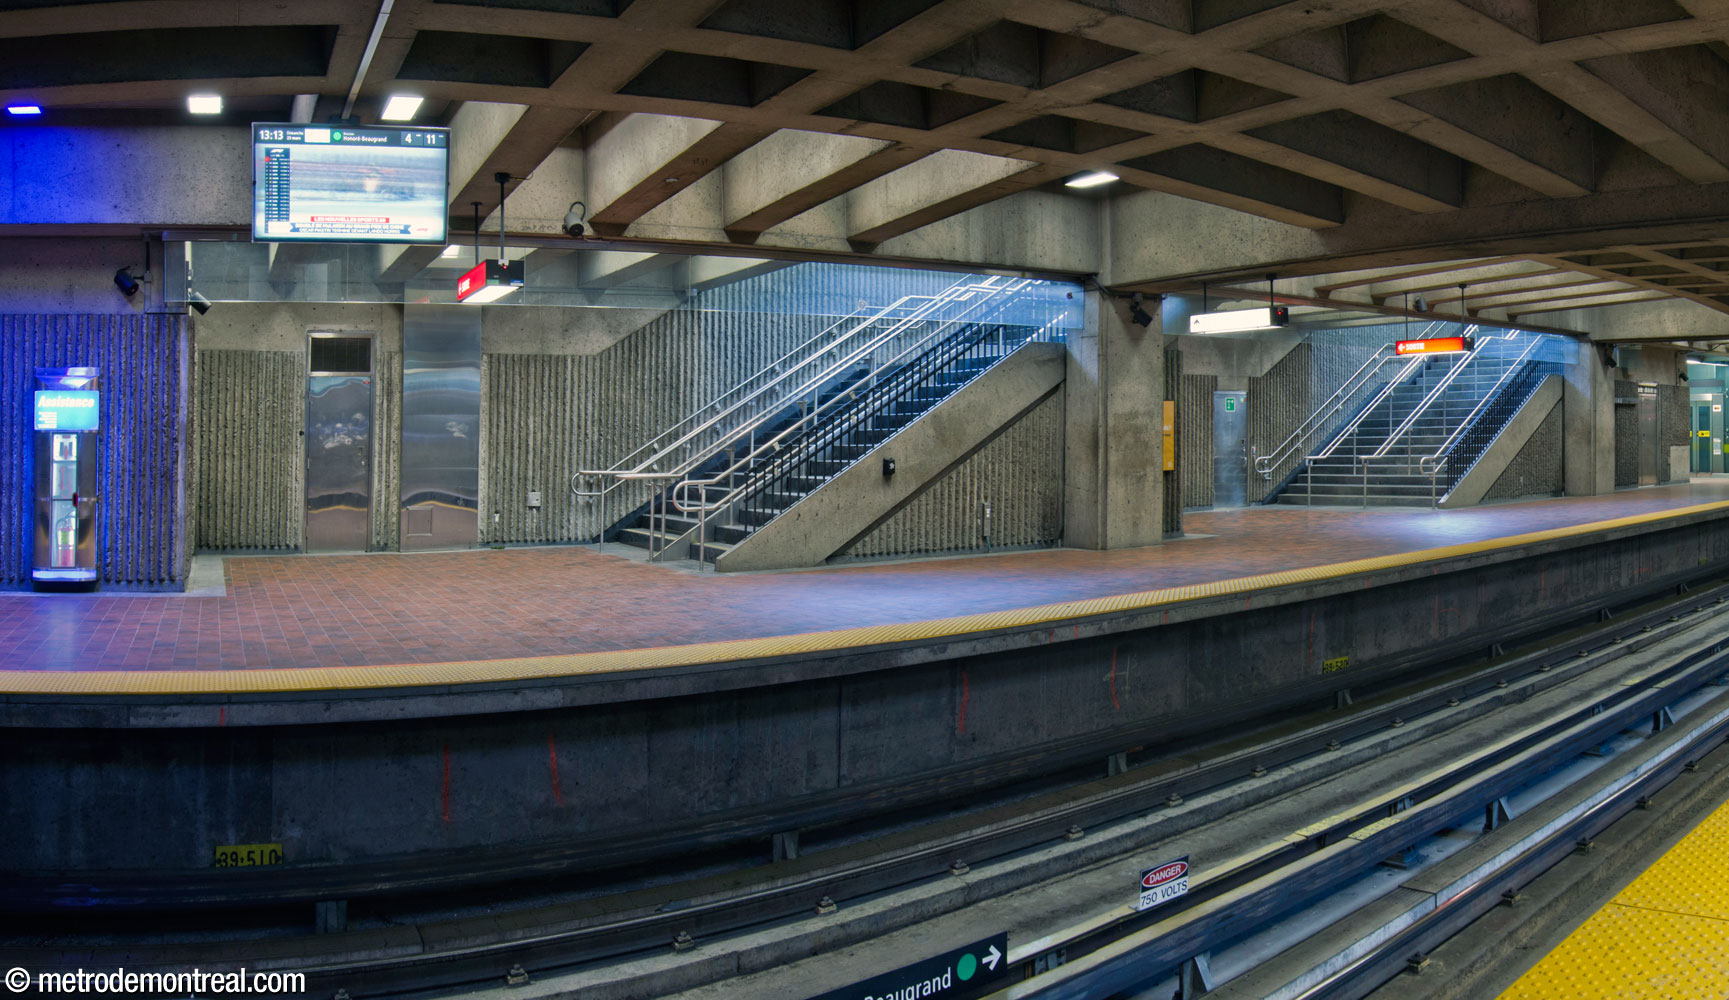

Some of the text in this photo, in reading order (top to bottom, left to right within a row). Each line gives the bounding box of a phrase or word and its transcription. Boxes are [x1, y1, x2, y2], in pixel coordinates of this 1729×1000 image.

[259, 130, 284, 140] 13:13
[405, 133, 412, 144] 4
[426, 134, 436, 144] 11
[38, 395, 95, 408] Assistance
[1150, 865, 1181, 884] DANGER
[1141, 880, 1188, 907] 750 VOLTS
